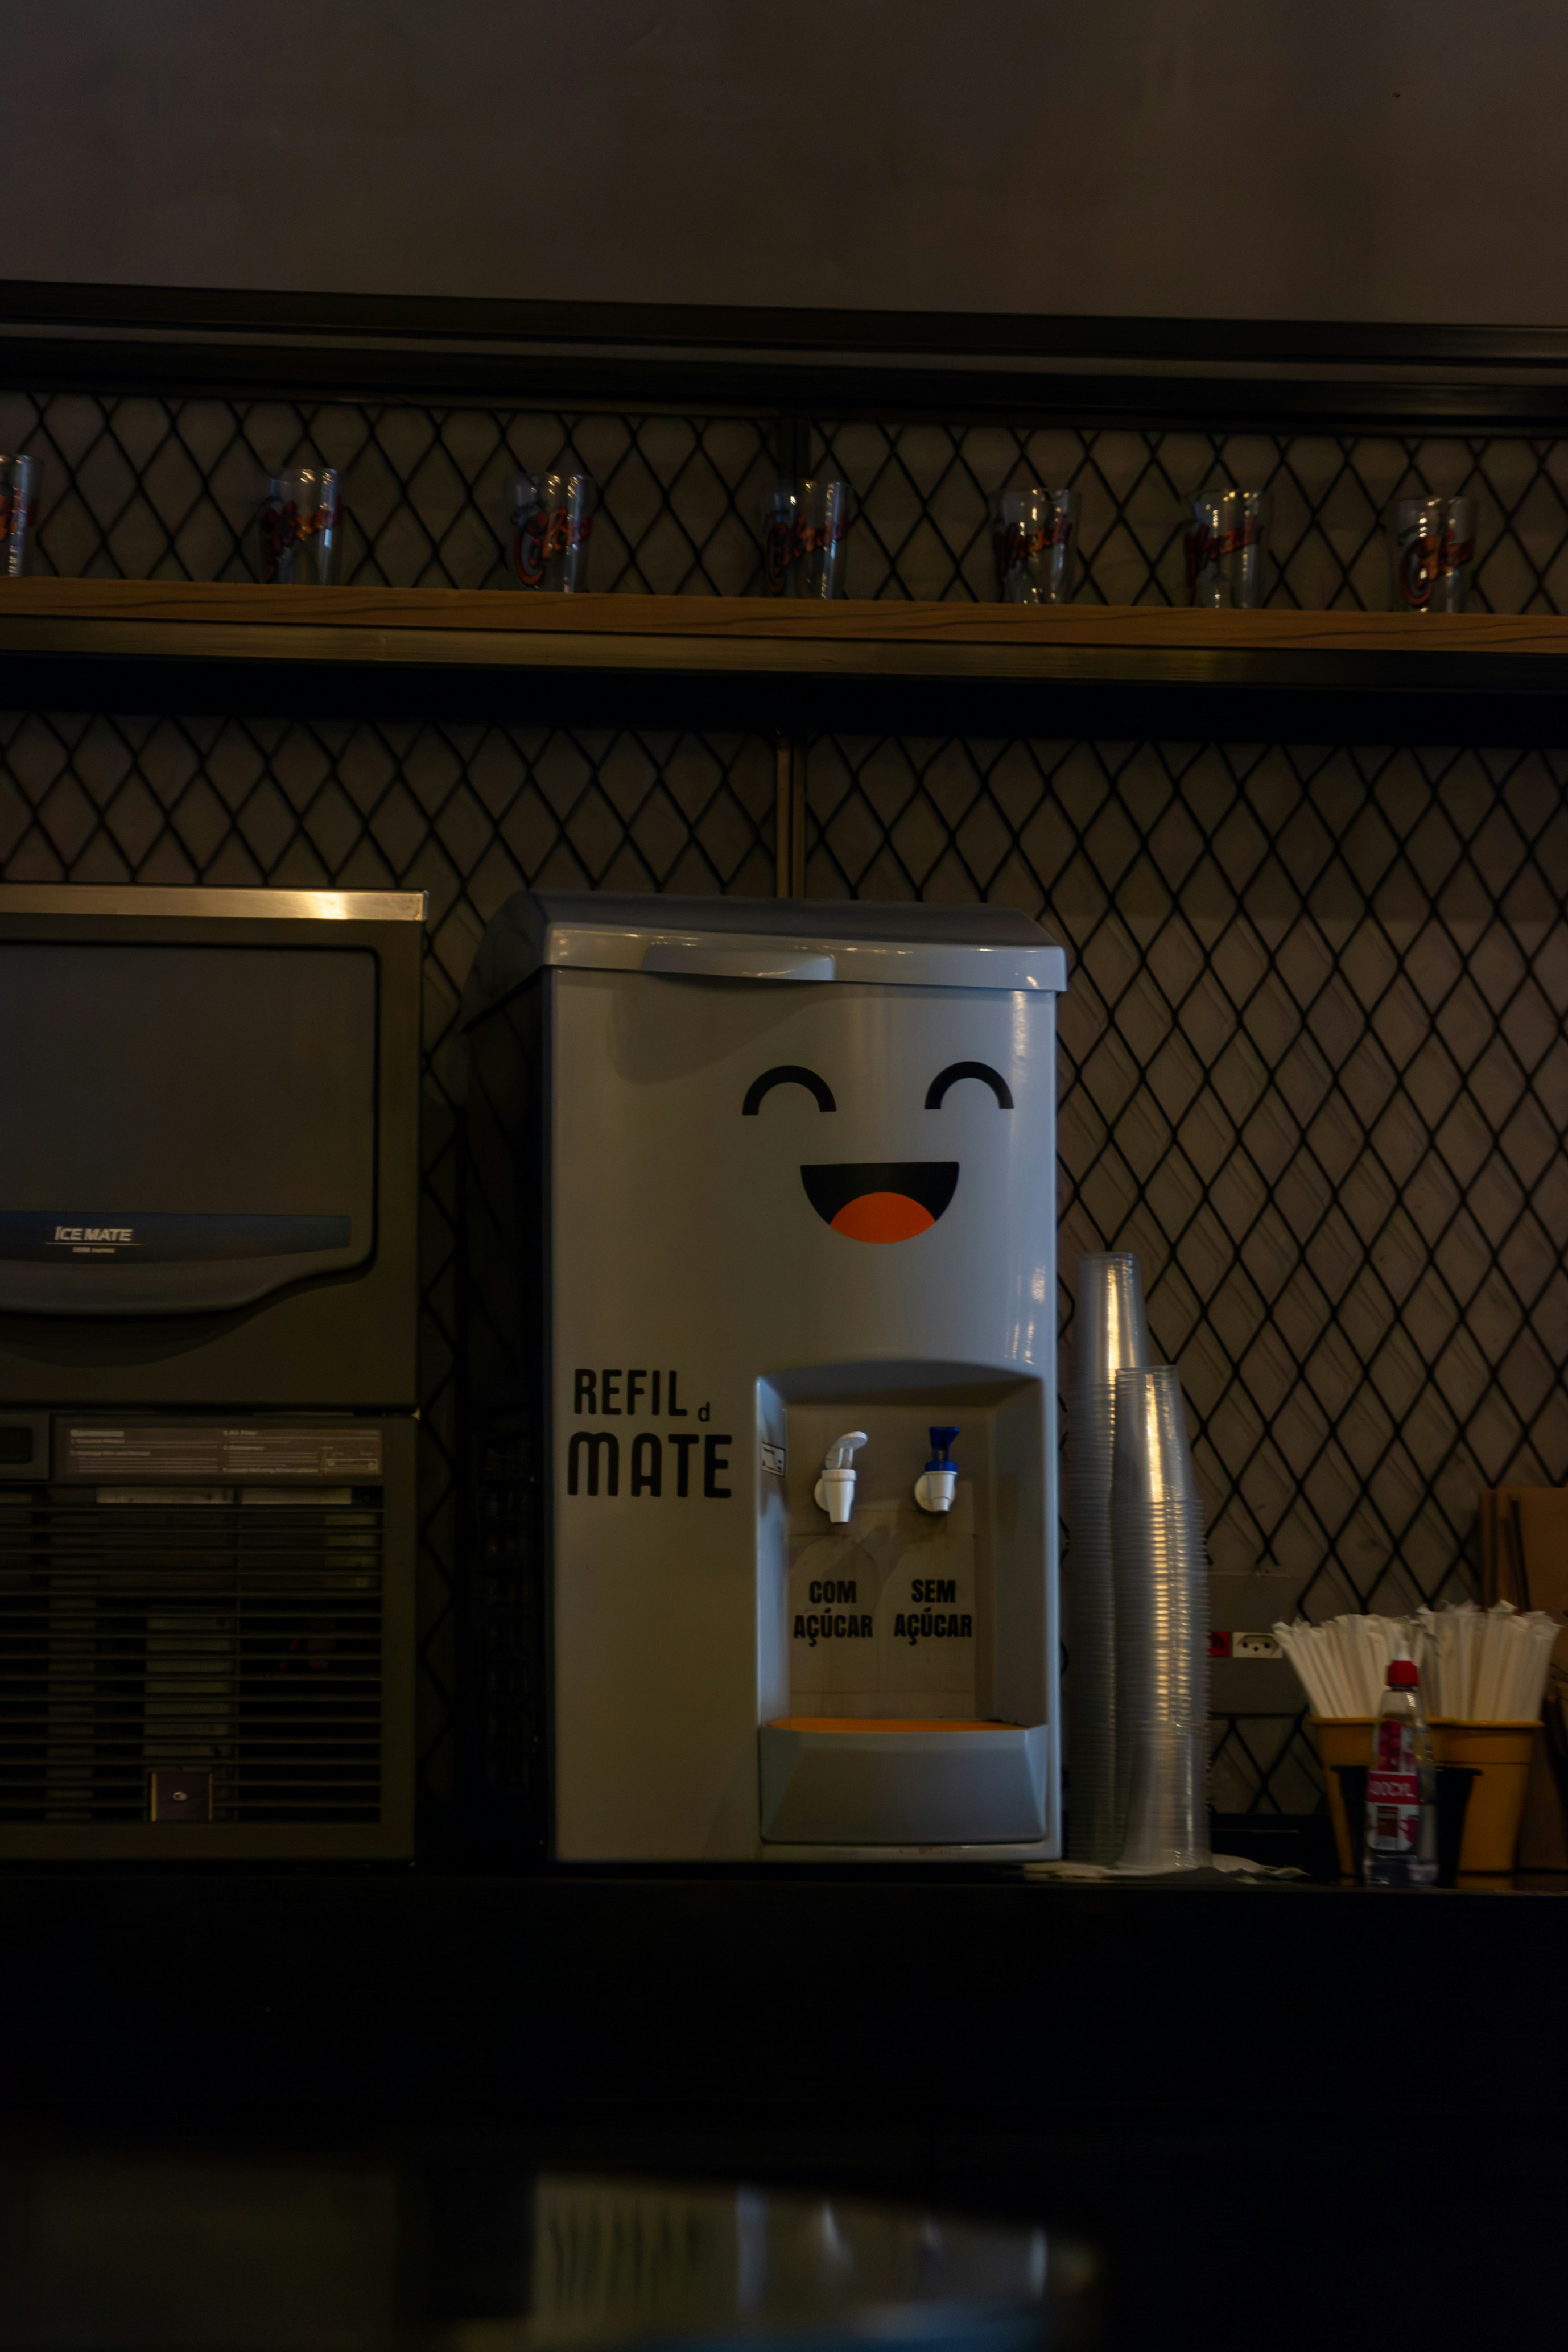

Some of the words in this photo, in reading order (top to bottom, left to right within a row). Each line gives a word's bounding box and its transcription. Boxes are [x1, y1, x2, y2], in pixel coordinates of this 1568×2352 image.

[54, 1225, 83, 1240] ICE
[84, 1228, 134, 1241] MATE
[574, 1368, 688, 1417] REFIL
[698, 1401, 711, 1422] d
[568, 1431, 732, 1499] MATE
[809, 1580, 857, 1604] COM
[911, 1579, 956, 1603] SEM
[794, 1607, 873, 1647] AÇÚCAR
[894, 1607, 972, 1645] AÇÚCAR
